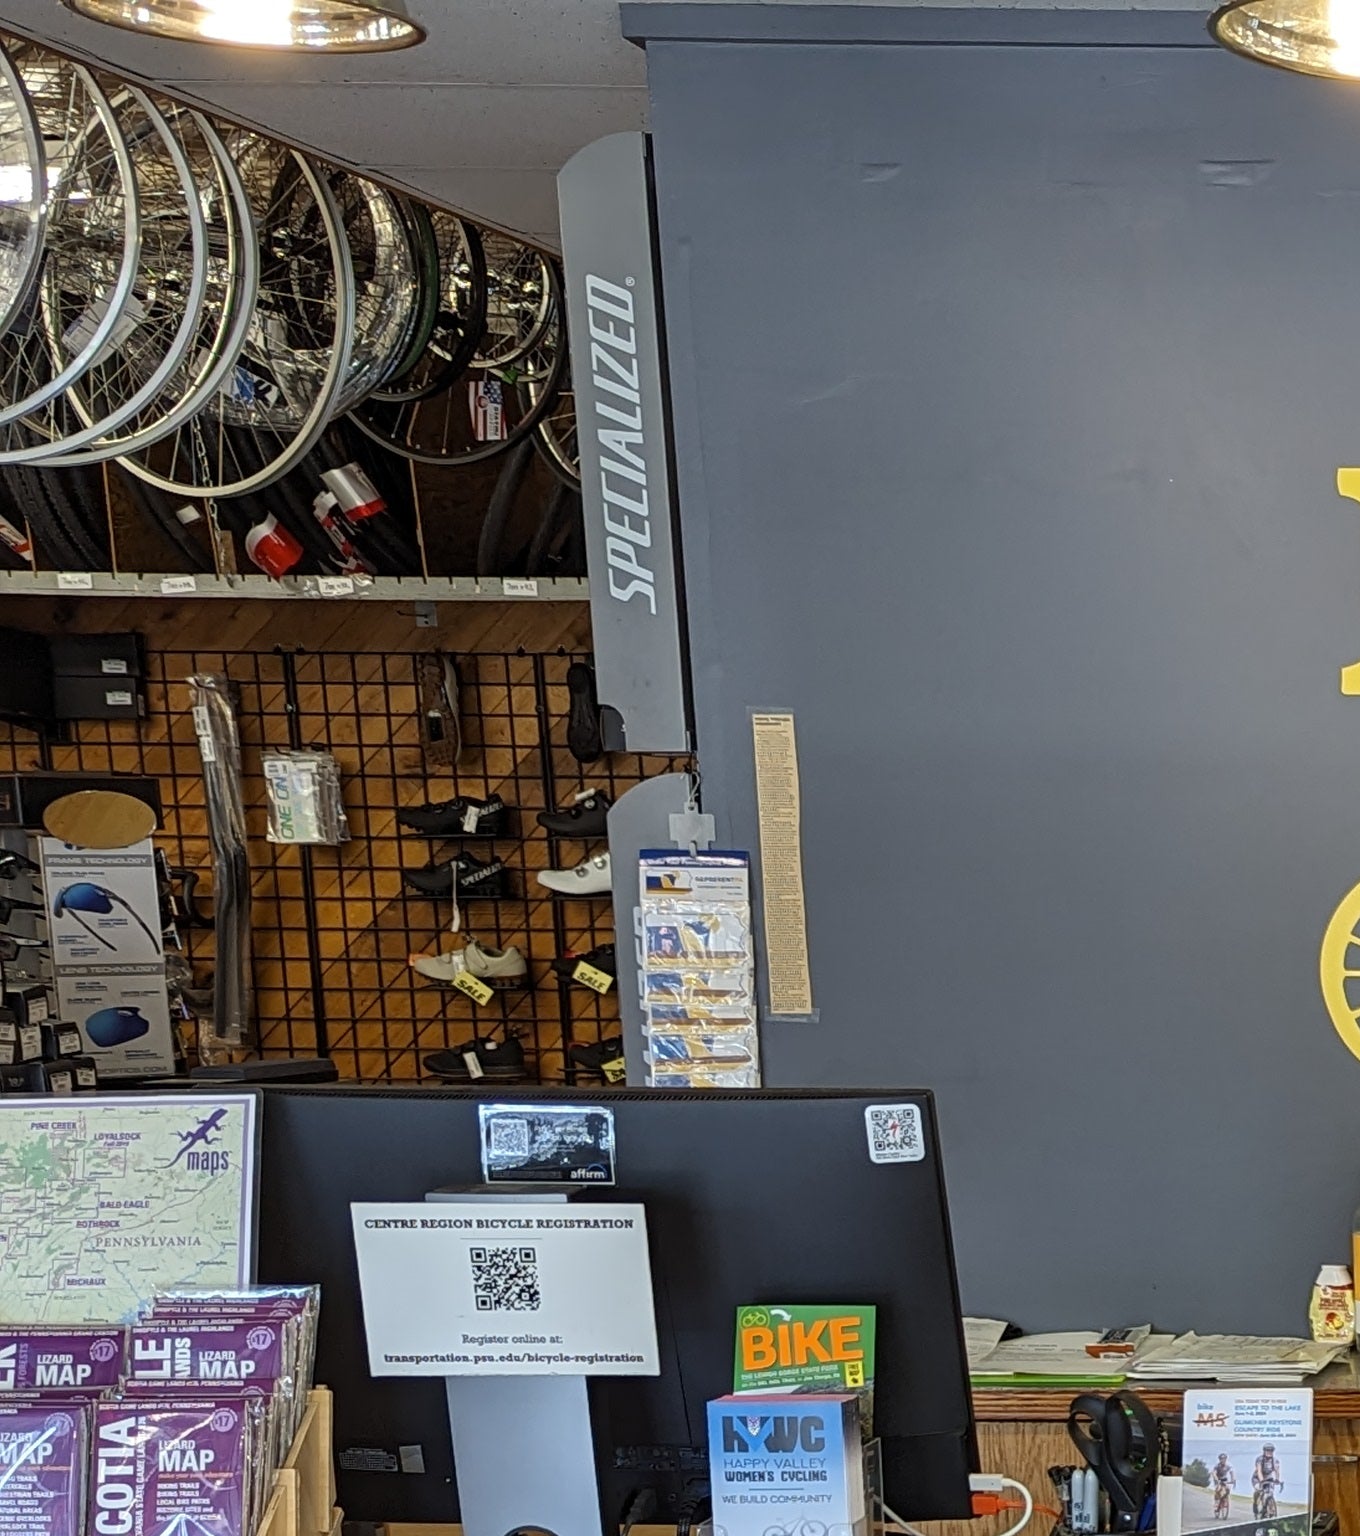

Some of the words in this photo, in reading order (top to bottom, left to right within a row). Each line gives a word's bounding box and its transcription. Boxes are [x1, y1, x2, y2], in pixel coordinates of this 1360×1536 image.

[585, 274, 657, 615] SPECIALIZED
[577, 970, 606, 991] SALE
[456, 974, 486, 1002] SALE
[187, 1151, 229, 1176] maps
[364, 1219, 418, 1229] CENTRE
[420, 1219, 473, 1229] REGION
[476, 1219, 534, 1229] BICYCLE
[536, 1218, 634, 1229] REGISTRATION
[96, 1236, 202, 1248] PENNSYLVANIA
[461, 1334, 509, 1344] Register
[511, 1334, 547, 1343] online
[549, 1334, 563, 1343] at:
[742, 1316, 864, 1371] BIKE
[37, 1354, 73, 1364] LIZARD
[384, 1352, 644, 1364] transportation.psu.edu/bicycle-registration
[35, 1364, 92, 1386] MAP
[724, 1459, 769, 1469] HAPPY
[773, 1458, 826, 1469] VALLEY
[724, 1470, 775, 1482] WOMEN'S
[780, 1470, 827, 1482] CYCLING
